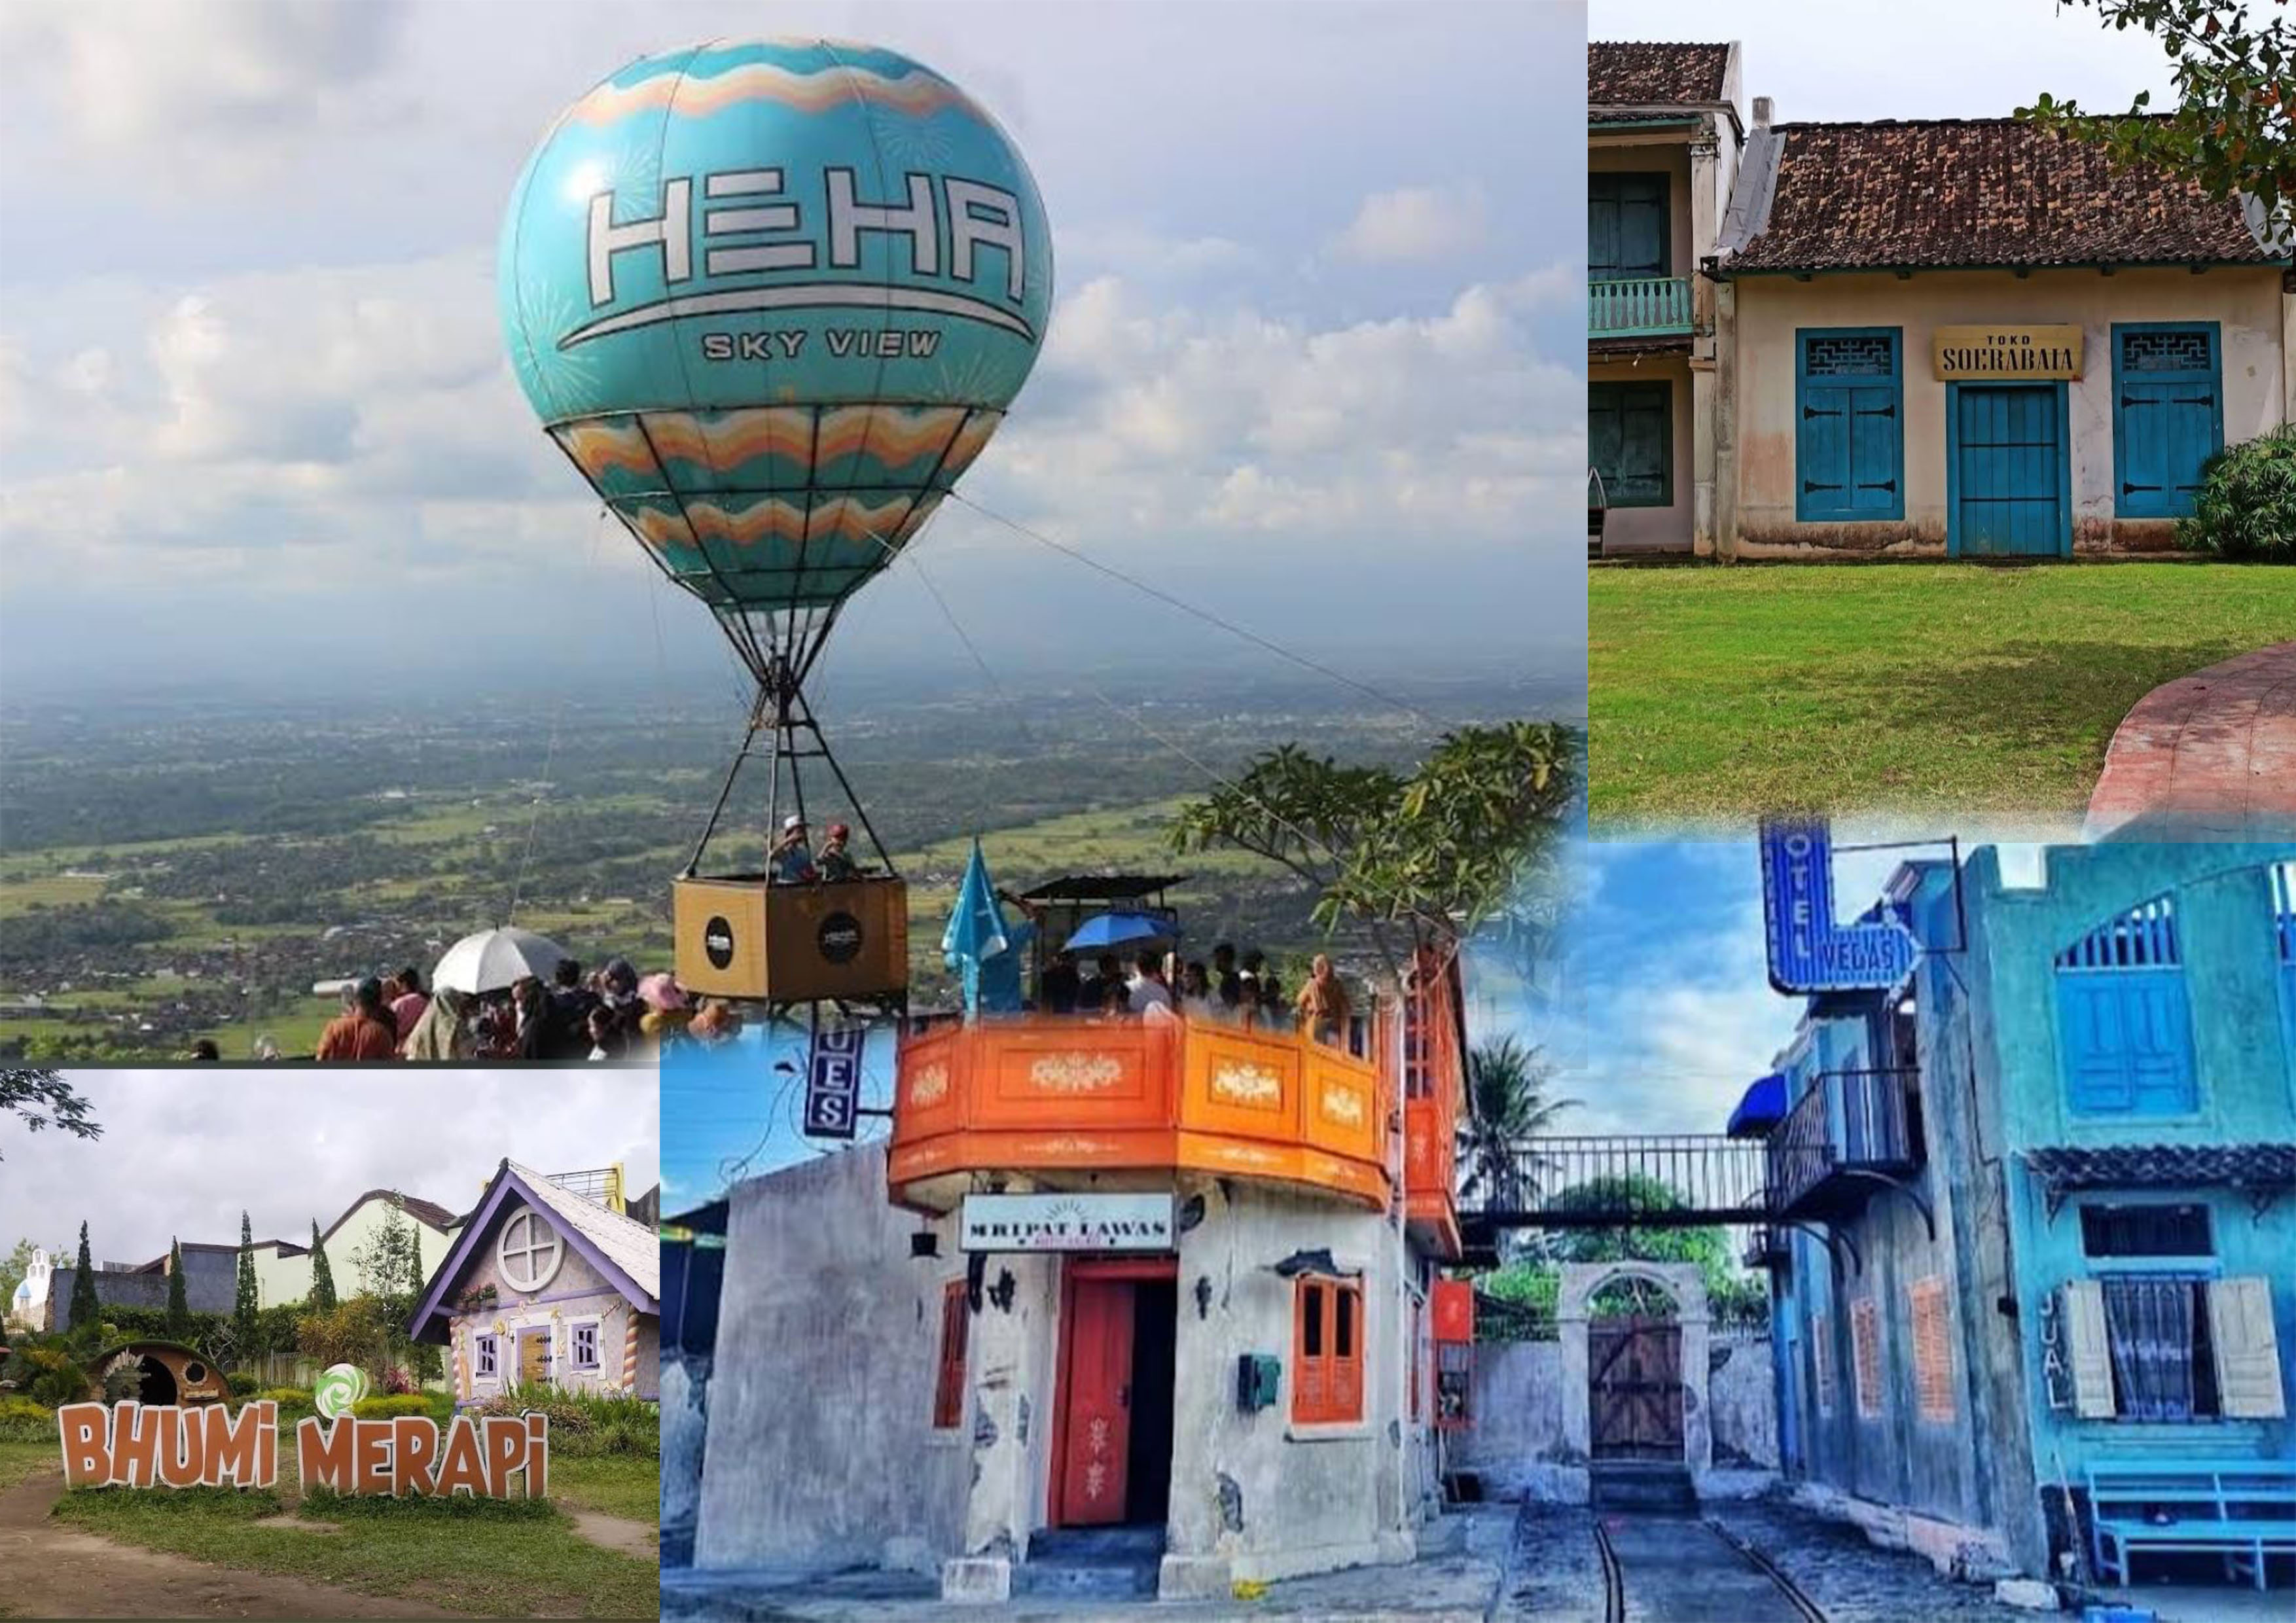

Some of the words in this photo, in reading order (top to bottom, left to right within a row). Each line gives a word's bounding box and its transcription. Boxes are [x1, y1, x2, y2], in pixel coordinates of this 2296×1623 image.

[586, 166, 1026, 309] HEHA
[702, 331, 805, 360] SKY
[827, 330, 942, 359] VIEW
[1987, 335, 2031, 346] TOKO
[1943, 348, 2073, 371] SOERABAIA
[1821, 940, 1895, 971] VEGAS
[2039, 1291, 2067, 1408] JUAL
